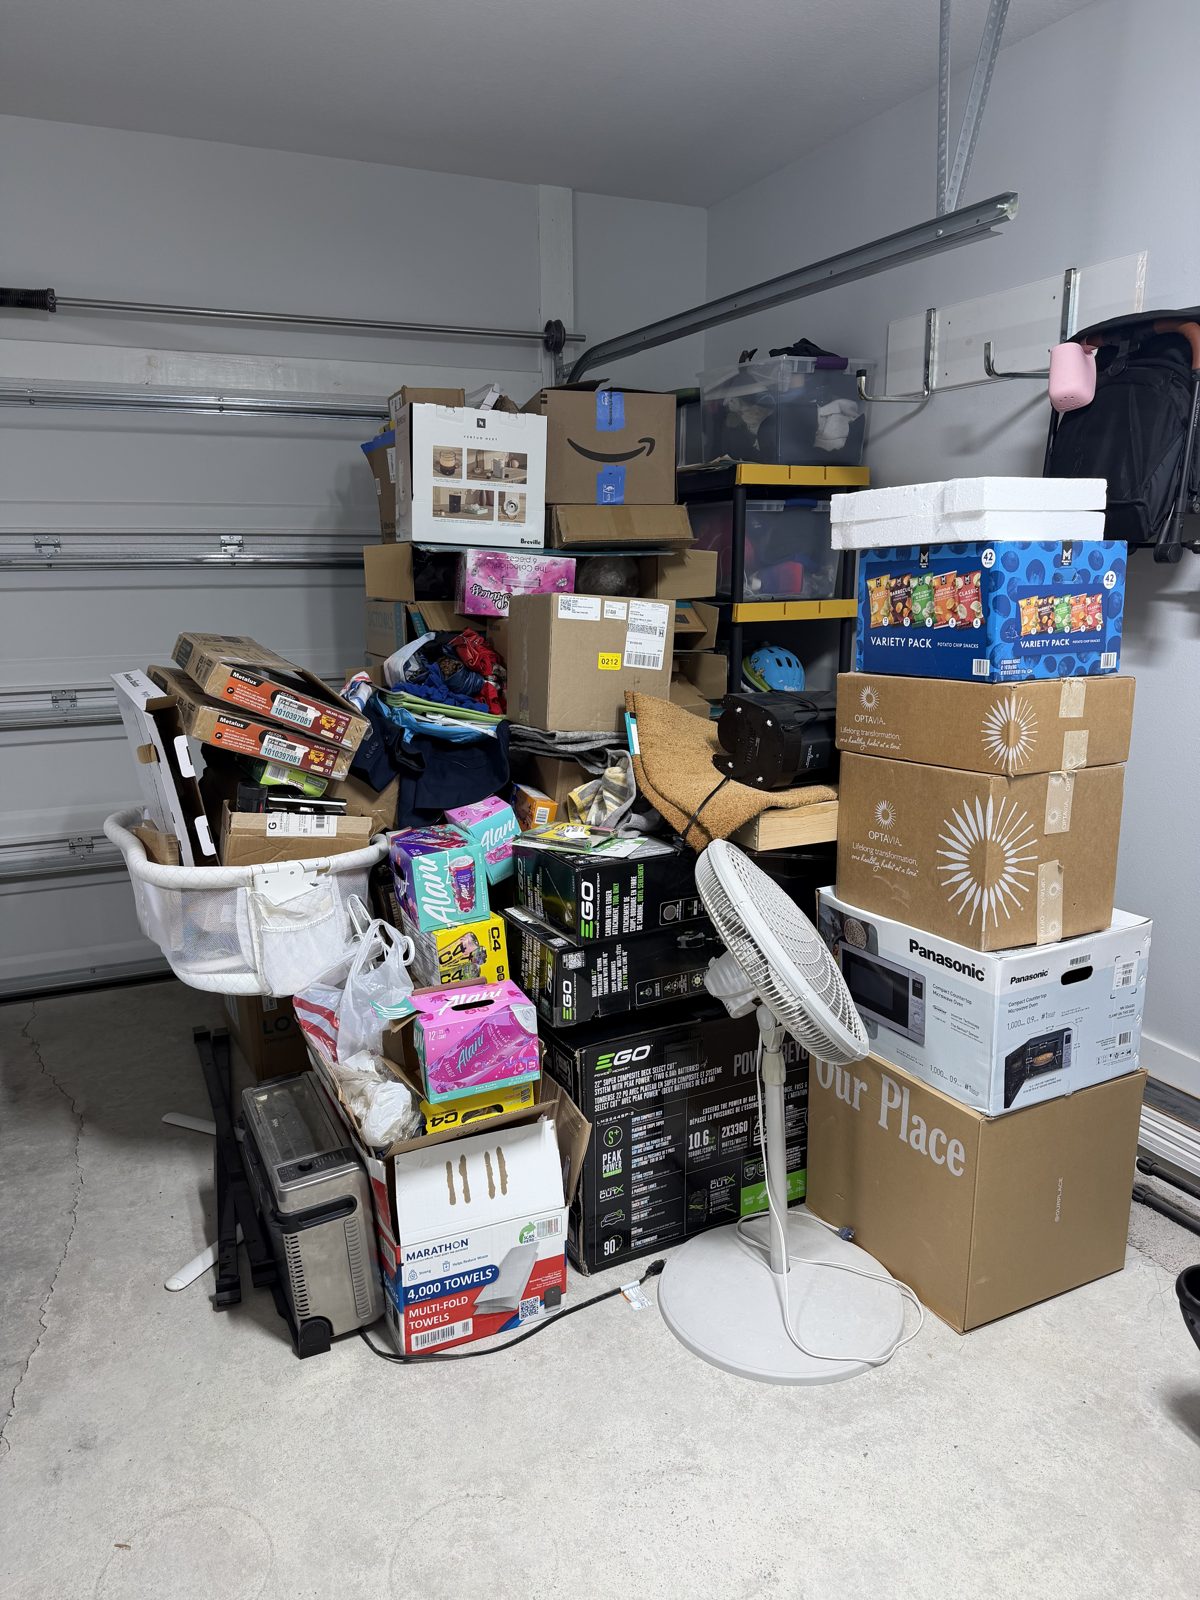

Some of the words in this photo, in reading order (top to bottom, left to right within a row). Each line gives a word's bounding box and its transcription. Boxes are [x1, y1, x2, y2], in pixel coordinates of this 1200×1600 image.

[984, 552, 993, 561] 42
[1105, 574, 1114, 582] 42
[870, 637, 906, 646] VARIETY
[908, 638, 932, 648] PACK
[1020, 640, 1051, 648] VARIETY
[601, 658, 618, 666] 0212
[232, 672, 257, 685] Metalux
[220, 717, 244, 728] Metalux
[868, 830, 902, 847] OPTAVIA
[581, 881, 594, 938] EGO
[491, 927, 501, 952] C4
[439, 942, 467, 965] C4
[909, 938, 985, 982] Panasonic
[441, 969, 463, 984] C4
[1010, 969, 1048, 985] Panasonic
[438, 989, 503, 1016] Alani
[562, 980, 572, 1020] EGO
[1008, 999, 1025, 1007] Compact
[1026, 993, 1047, 1003] Countertop
[456, 1031, 485, 1073] Alani
[595, 1045, 651, 1070] EGO
[603, 1077, 617, 1086] SUPER
[617, 1071, 640, 1084] COMPOSITE
[641, 1069, 652, 1077] DECK
[652, 1065, 667, 1075] SELECT
[616, 1091, 622, 1099] 22
[622, 1089, 628, 1097] PO
[629, 1087, 639, 1096] AVEC
[640, 1082, 657, 1093] PLATEAU
[664, 1077, 677, 1087] SUPER
[678, 1072, 700, 1084] COMPOSITE
[705, 1065, 722, 1076] SYSTÈME
[595, 1086, 611, 1096] SYSTEM
[612, 1084, 623, 1092] WITH
[624, 1081, 635, 1090] PEAK
[595, 1102, 609, 1112] SELECT
[621, 1096, 632, 1105] AVEC
[632, 1094, 643, 1103] PEAK
[702, 1105, 720, 1115] EXCEEDS
[728, 1099, 742, 1108] POWER
[430, 1111, 458, 1127] C4
[713, 1108, 734, 1119] PUISSANCE
[816, 1060, 868, 1111] Our
[878, 1073, 966, 1177] Place
[688, 1129, 709, 1150] 10.6
[722, 1120, 748, 1138] 2X3360
[602, 1149, 622, 1164] PEAK
[602, 1160, 622, 1173] POWER
[406, 1238, 469, 1261] MARATHON
[604, 1239, 616, 1256] 90
[408, 1283, 441, 1300] 4,000
[409, 1296, 469, 1319] MULTI-FOLD
[409, 1312, 450, 1330] TOWELS
